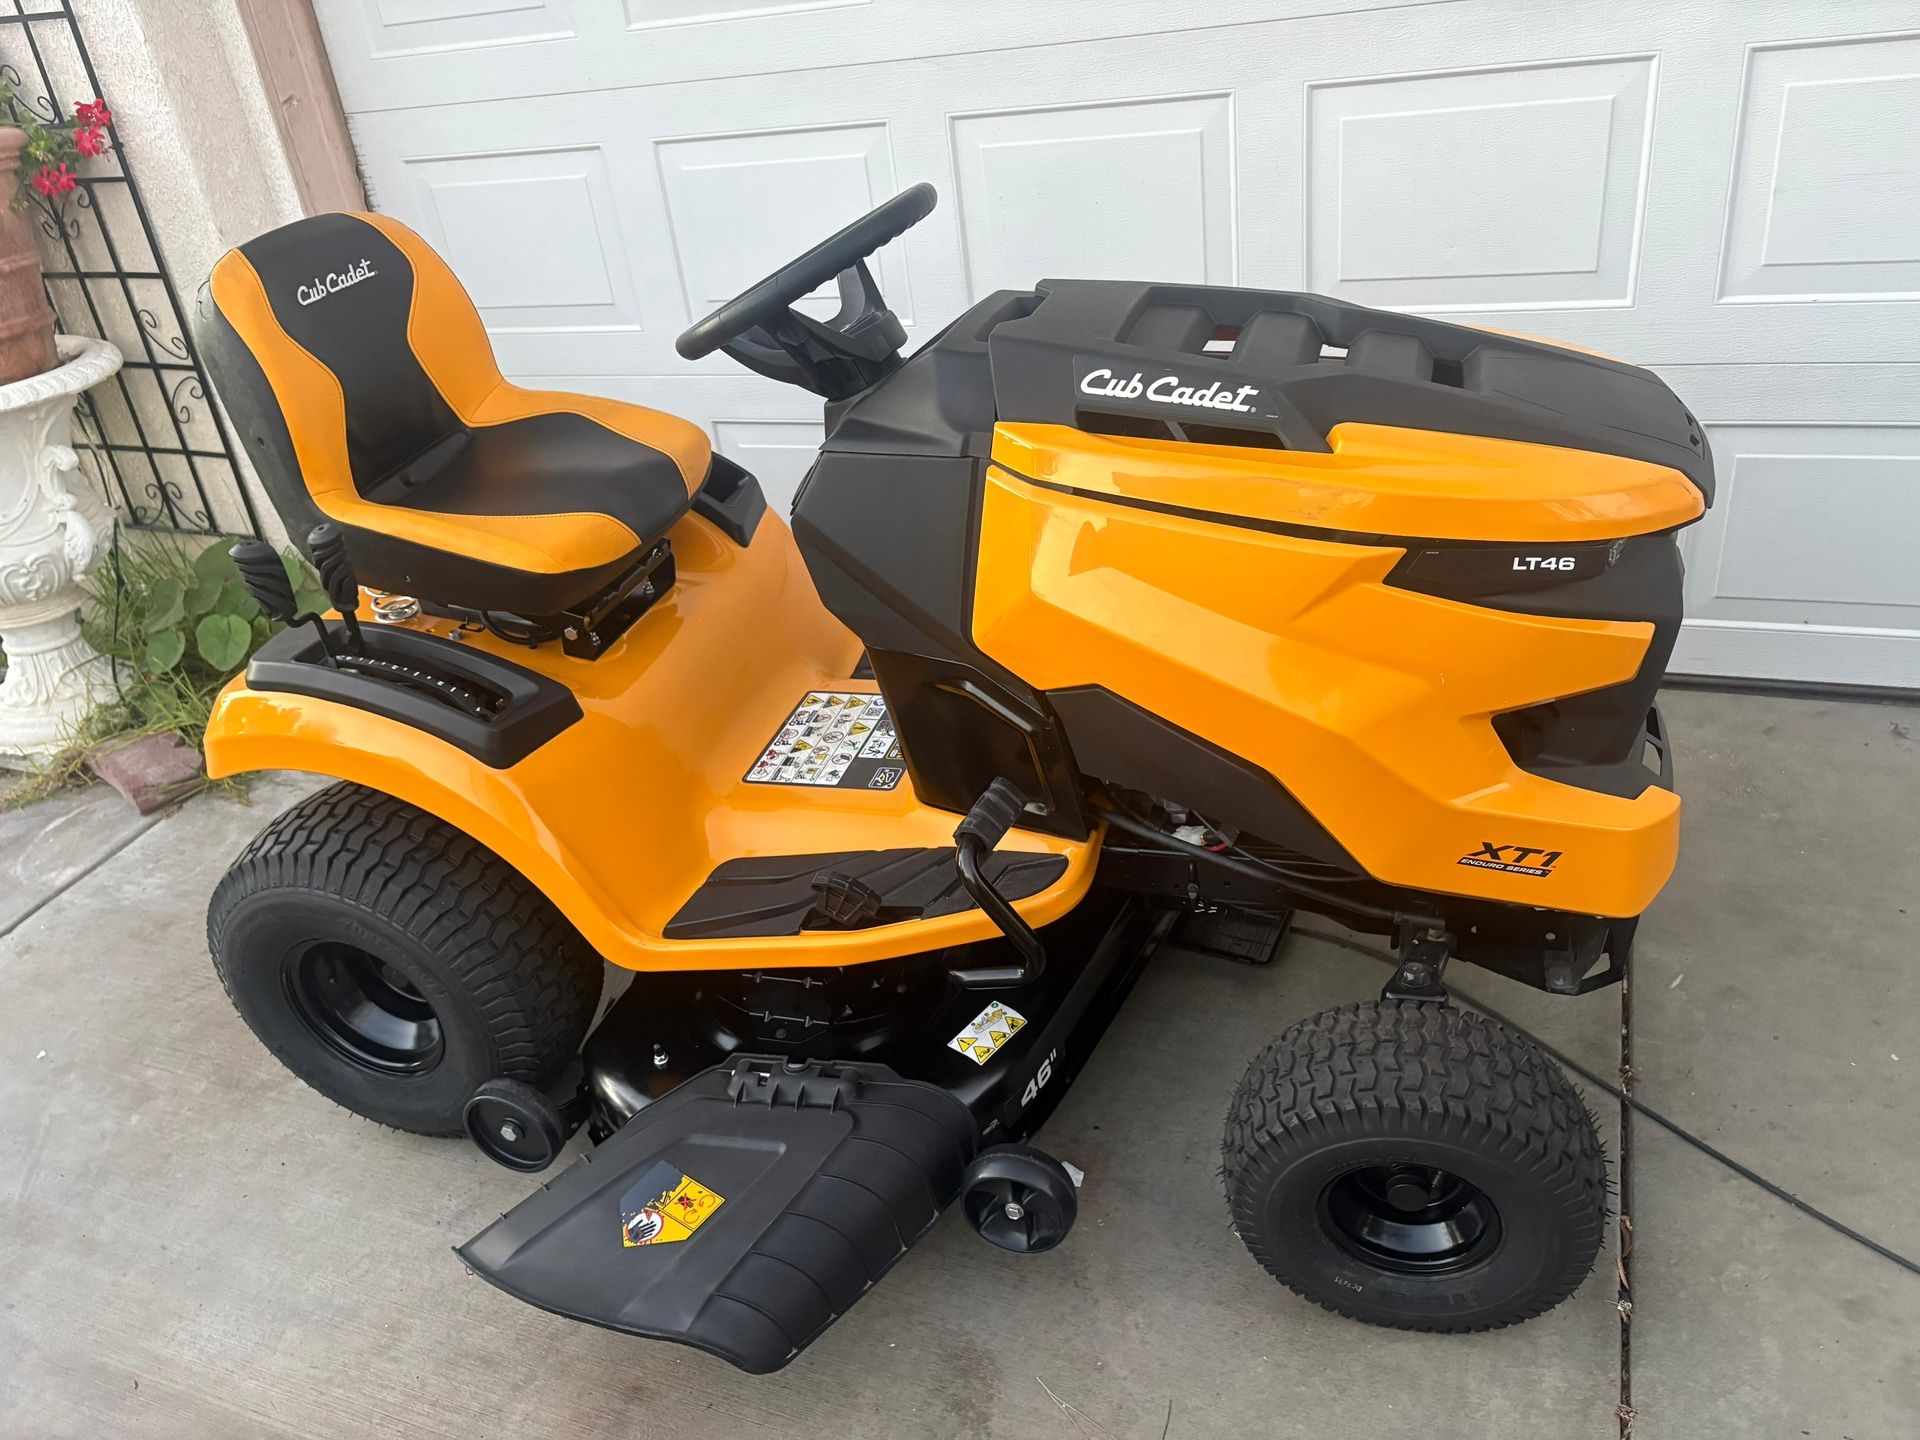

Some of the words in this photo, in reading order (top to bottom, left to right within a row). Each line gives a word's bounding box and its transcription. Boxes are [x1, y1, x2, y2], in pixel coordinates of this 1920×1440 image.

[297, 278, 327, 305] Cub
[326, 259, 375, 293] Cadet
[1080, 368, 1144, 399] Cub
[1146, 376, 1259, 412] Cadet
[1512, 557, 1576, 571] LT46
[1460, 858, 1505, 869] ENDURO
[1506, 865, 1543, 875] SERIES
[1466, 842, 1563, 868] XT1
[1021, 1048, 1057, 1107] 46"
